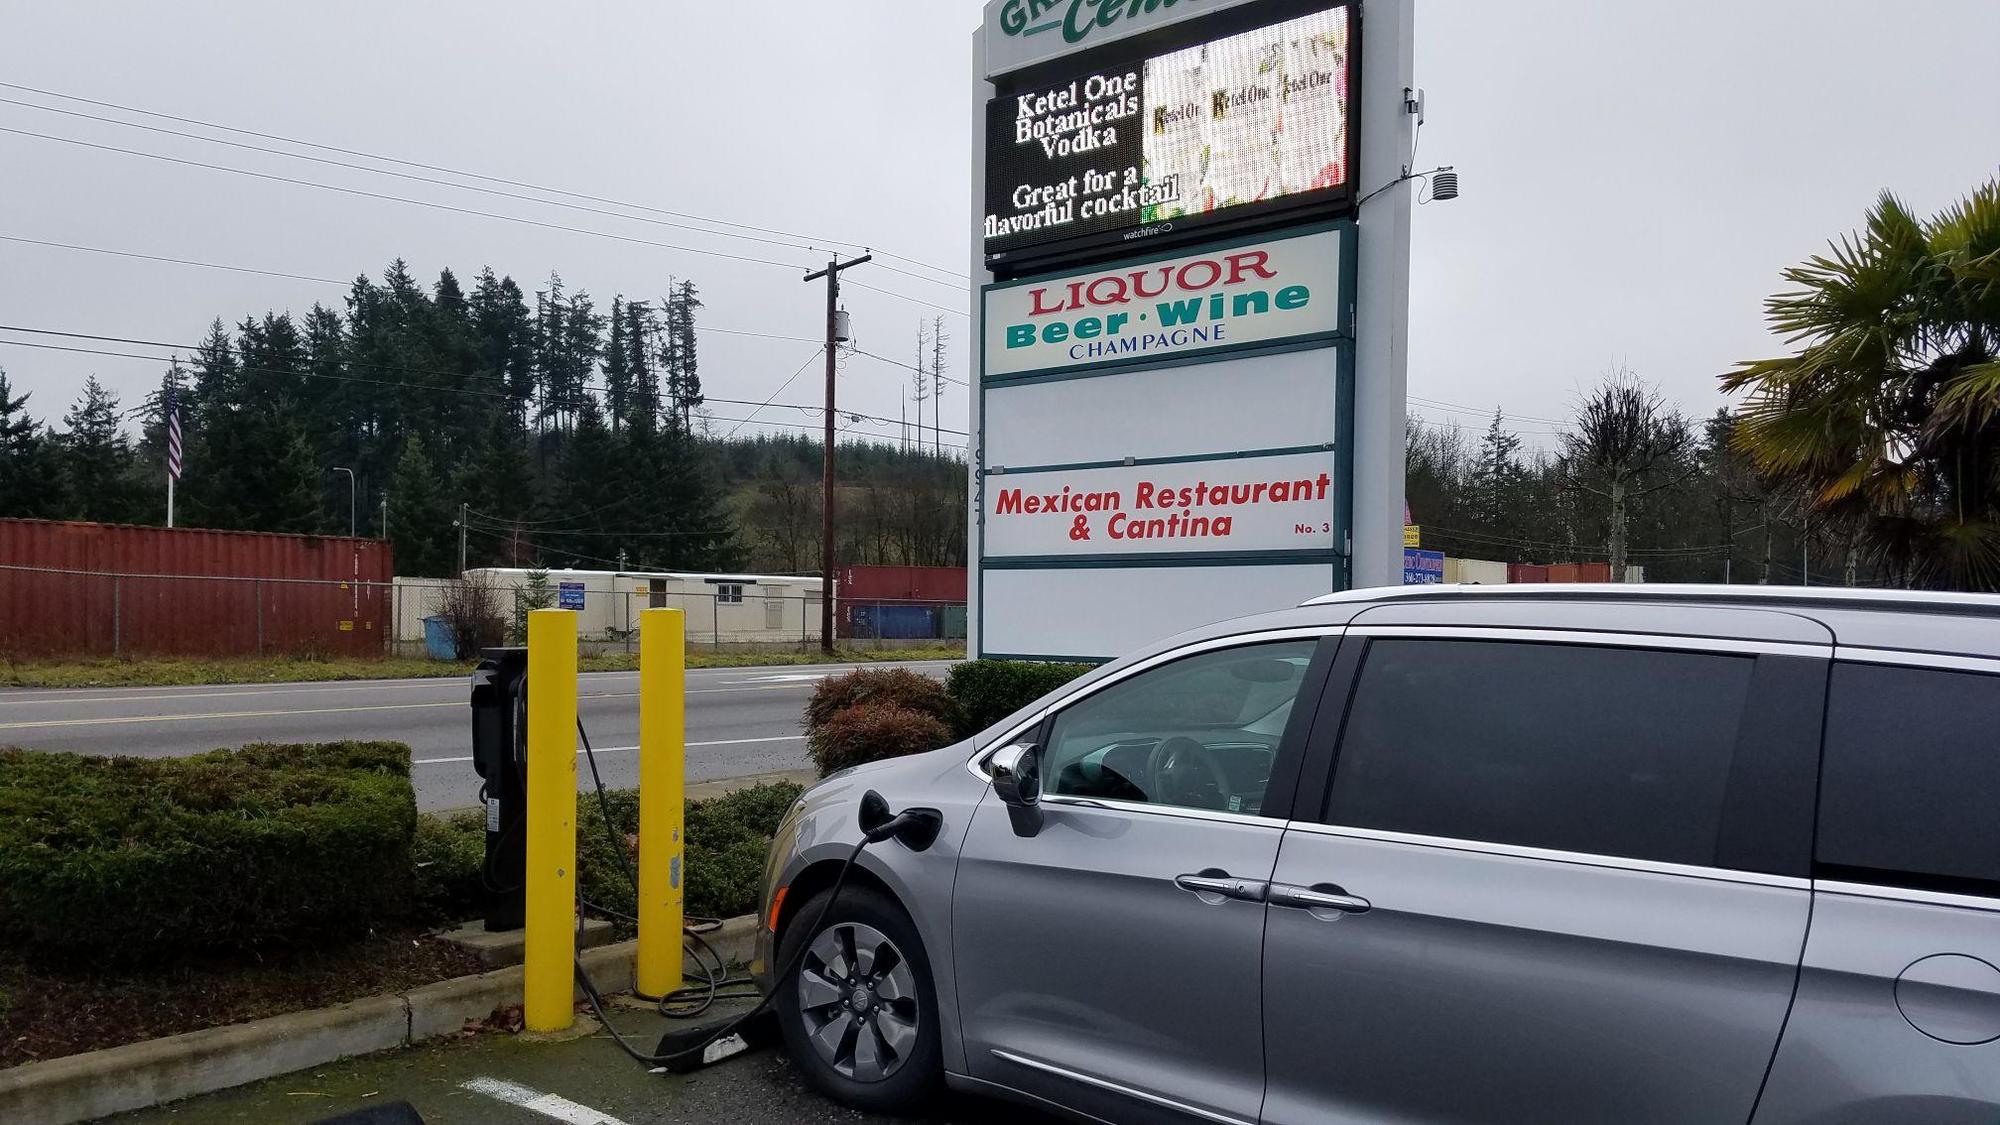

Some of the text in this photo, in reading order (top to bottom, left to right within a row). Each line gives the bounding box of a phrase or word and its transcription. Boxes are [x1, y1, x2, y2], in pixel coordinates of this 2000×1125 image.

[1017, 71, 1137, 119] Ketel One
[1016, 95, 1138, 143] Botanicals
[1040, 124, 1117, 159] Vodka
[983, 173, 1180, 238] flavorful cocktail
[1013, 166, 1138, 208] Great for a
[1123, 227, 1159, 240] watchfire
[1028, 250, 1278, 317] LIQUOR
[1006, 312, 1128, 349] Beer
[1069, 323, 1226, 360] CHAMPAGNE
[995, 473, 1330, 515] Mexican Restaurant
[1068, 509, 1232, 541] & Cantina
[1295, 522, 1330, 535] No. 3
